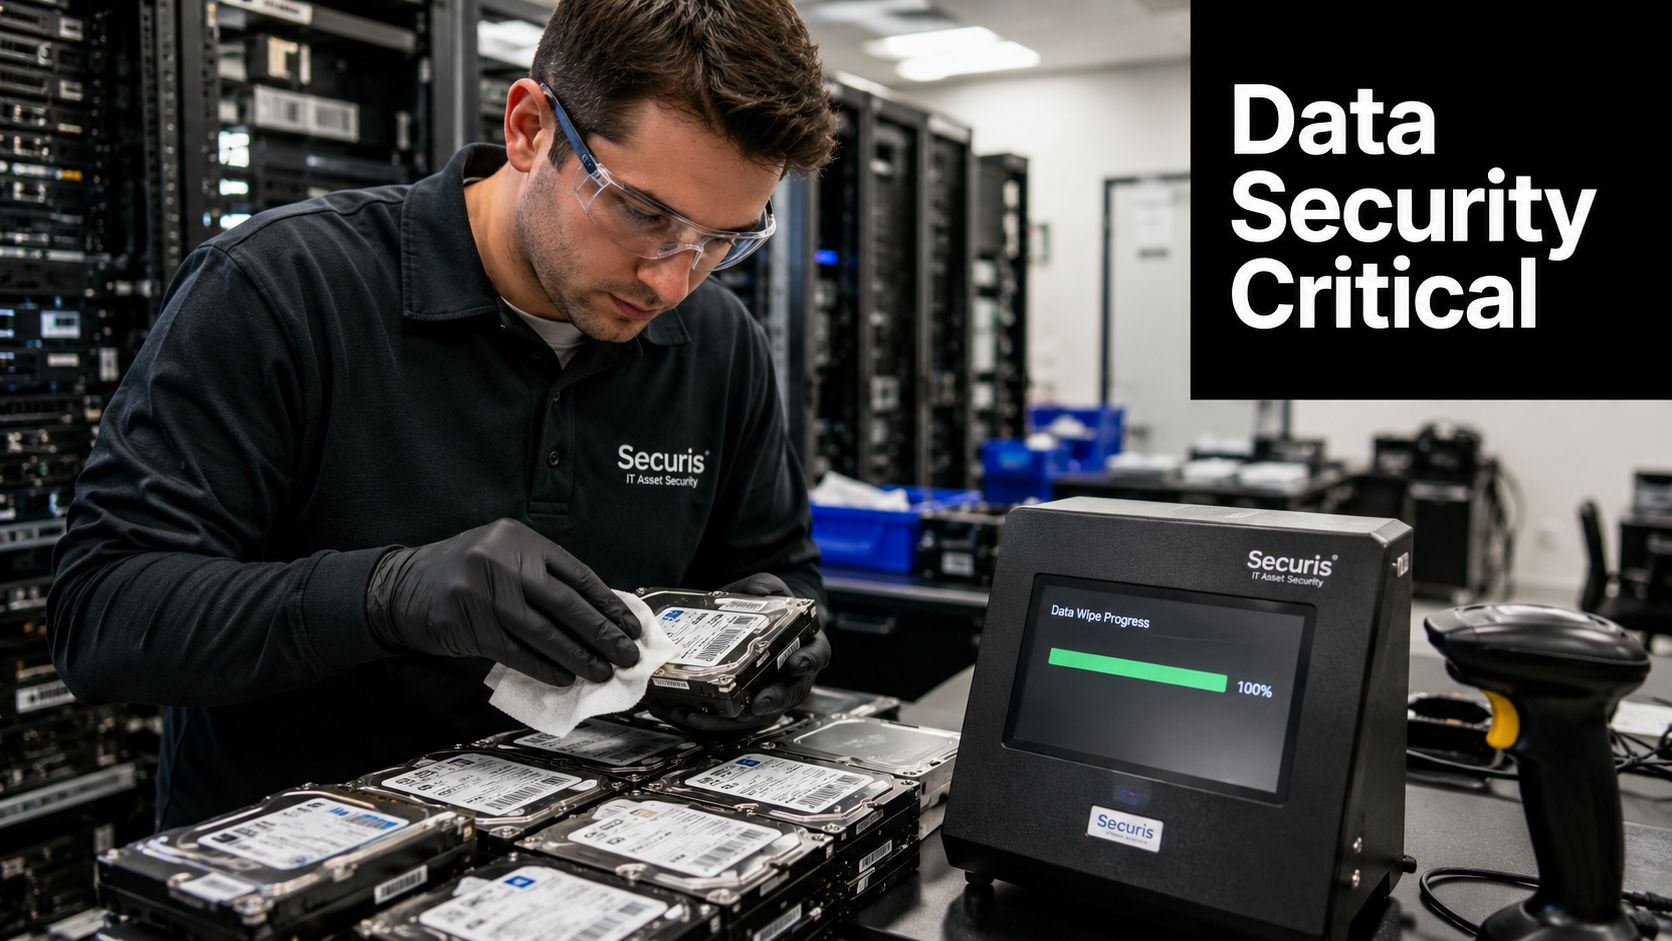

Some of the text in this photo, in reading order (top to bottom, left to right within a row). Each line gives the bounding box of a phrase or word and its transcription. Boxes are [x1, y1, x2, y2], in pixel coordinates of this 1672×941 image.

[617, 444, 705, 474] Securis
[626, 473, 699, 489] IT Asset Security
[1247, 550, 1332, 576] Securis
[1251, 571, 1324, 588] IT Asset Security
[1051, 604, 1150, 629] Data Wipe Progress
[1237, 680, 1273, 699] 100%
[1096, 813, 1155, 840] Securis
